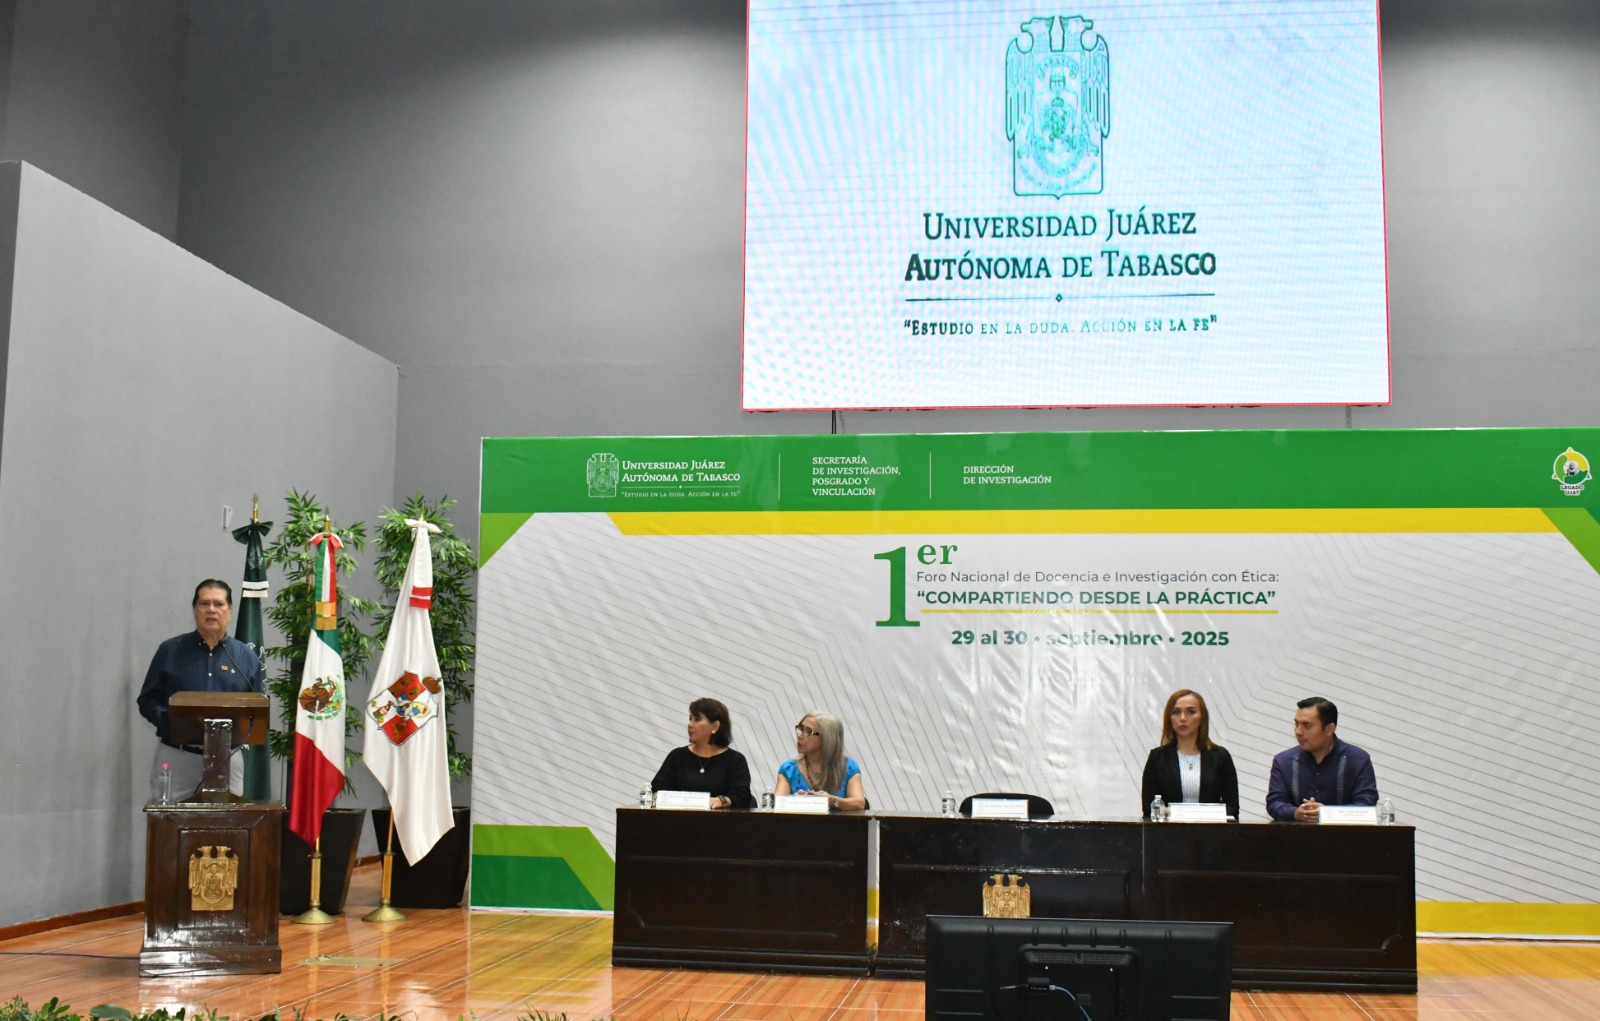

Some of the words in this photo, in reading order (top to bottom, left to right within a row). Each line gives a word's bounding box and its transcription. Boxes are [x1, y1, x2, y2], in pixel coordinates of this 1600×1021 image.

[923, 212, 1097, 240] UNIVERSIDAD
[1105, 205, 1197, 241] JUÁREZ
[904, 250, 1052, 281] AUTÓNOMA
[1061, 256, 1093, 278] DE
[1101, 250, 1217, 277] TABASCO
[980, 323, 998, 335] EN
[1006, 323, 1022, 334] LA
[1080, 318, 1137, 333] ACCIÓN
[1144, 320, 1162, 332] EN
[1169, 319, 1187, 331] LA
[622, 460, 688, 469] UNIVERSIDAD
[691, 459, 726, 471] JUÁREZ
[812, 455, 867, 464] SECRETARÍA
[812, 467, 825, 475] DE
[827, 465, 901, 475] INVESTIGACIÓN,
[963, 464, 1014, 474] DIRECCIÓN
[621, 472, 679, 482] AUTÓNOMA
[696, 472, 741, 482] TABASCO
[812, 477, 862, 485] POSGRADO
[863, 477, 870, 485] Y
[963, 476, 976, 484] DE
[978, 474, 1052, 484] INVESTIGACIÓN
[812, 487, 876, 496] VINCULACIÓN
[916, 571, 947, 582] Foro
[950, 571, 1009, 582] Nacional
[1014, 571, 1031, 582] de
[1035, 570, 1099, 582] Docencia
[1102, 573, 1111, 582] e
[1115, 570, 1208, 585] Investigación
[1211, 573, 1238, 582] con
[1241, 568, 1280, 582] Ética:
[917, 590, 1074, 605] “COMPARTIENDO
[1079, 591, 1141, 605] DESDE
[1146, 591, 1170, 605] LA
[1175, 588, 1276, 605] PRÁCTICA”
[951, 630, 975, 645] 29
[980, 629, 998, 645] al
[1003, 630, 1028, 645] 30
[1181, 631, 1230, 646] 2025
